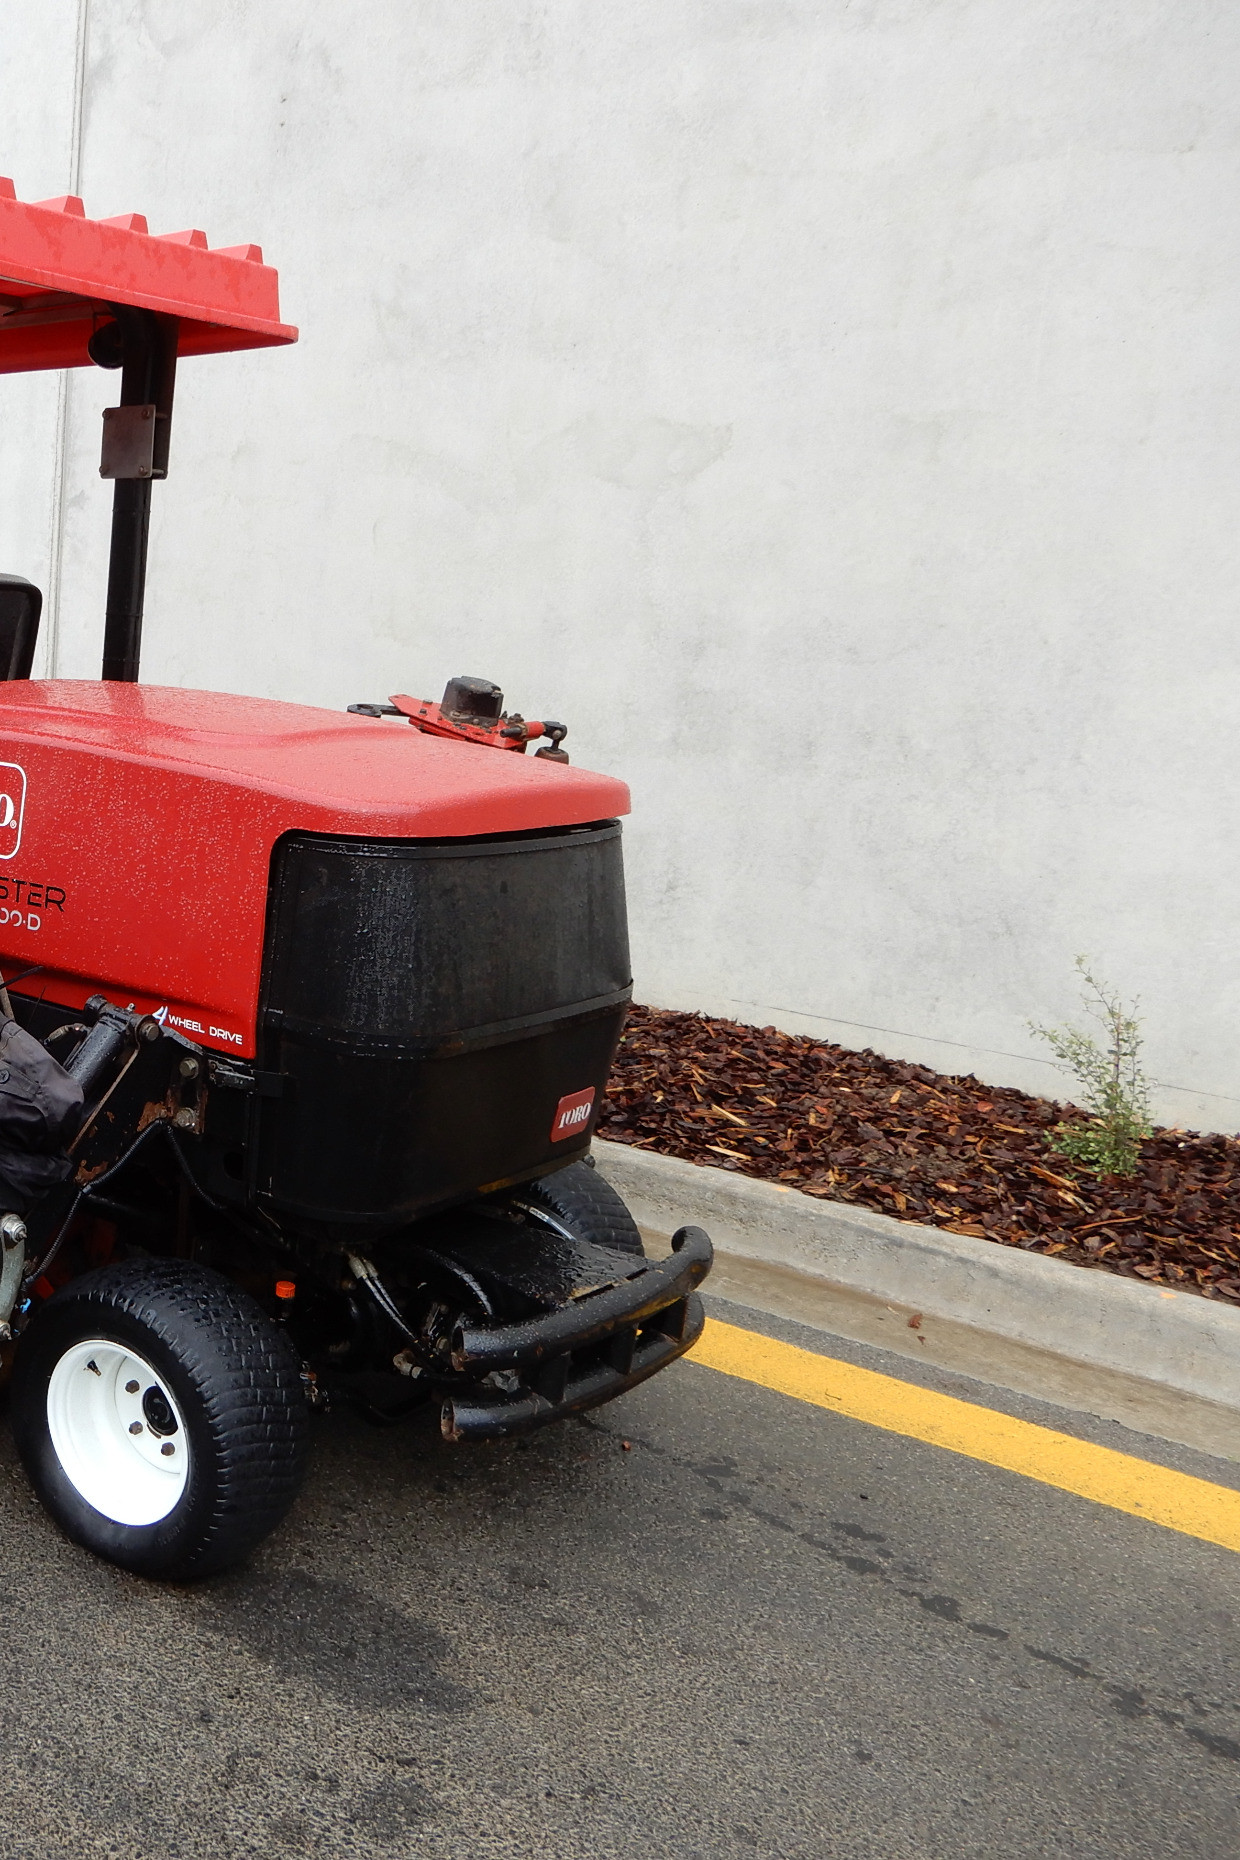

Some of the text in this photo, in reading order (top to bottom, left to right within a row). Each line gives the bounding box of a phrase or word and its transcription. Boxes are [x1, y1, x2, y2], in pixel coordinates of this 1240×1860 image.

[152, 1005, 243, 1045] 4 WHEEL DRIVE
[557, 1102, 591, 1129] TORO
